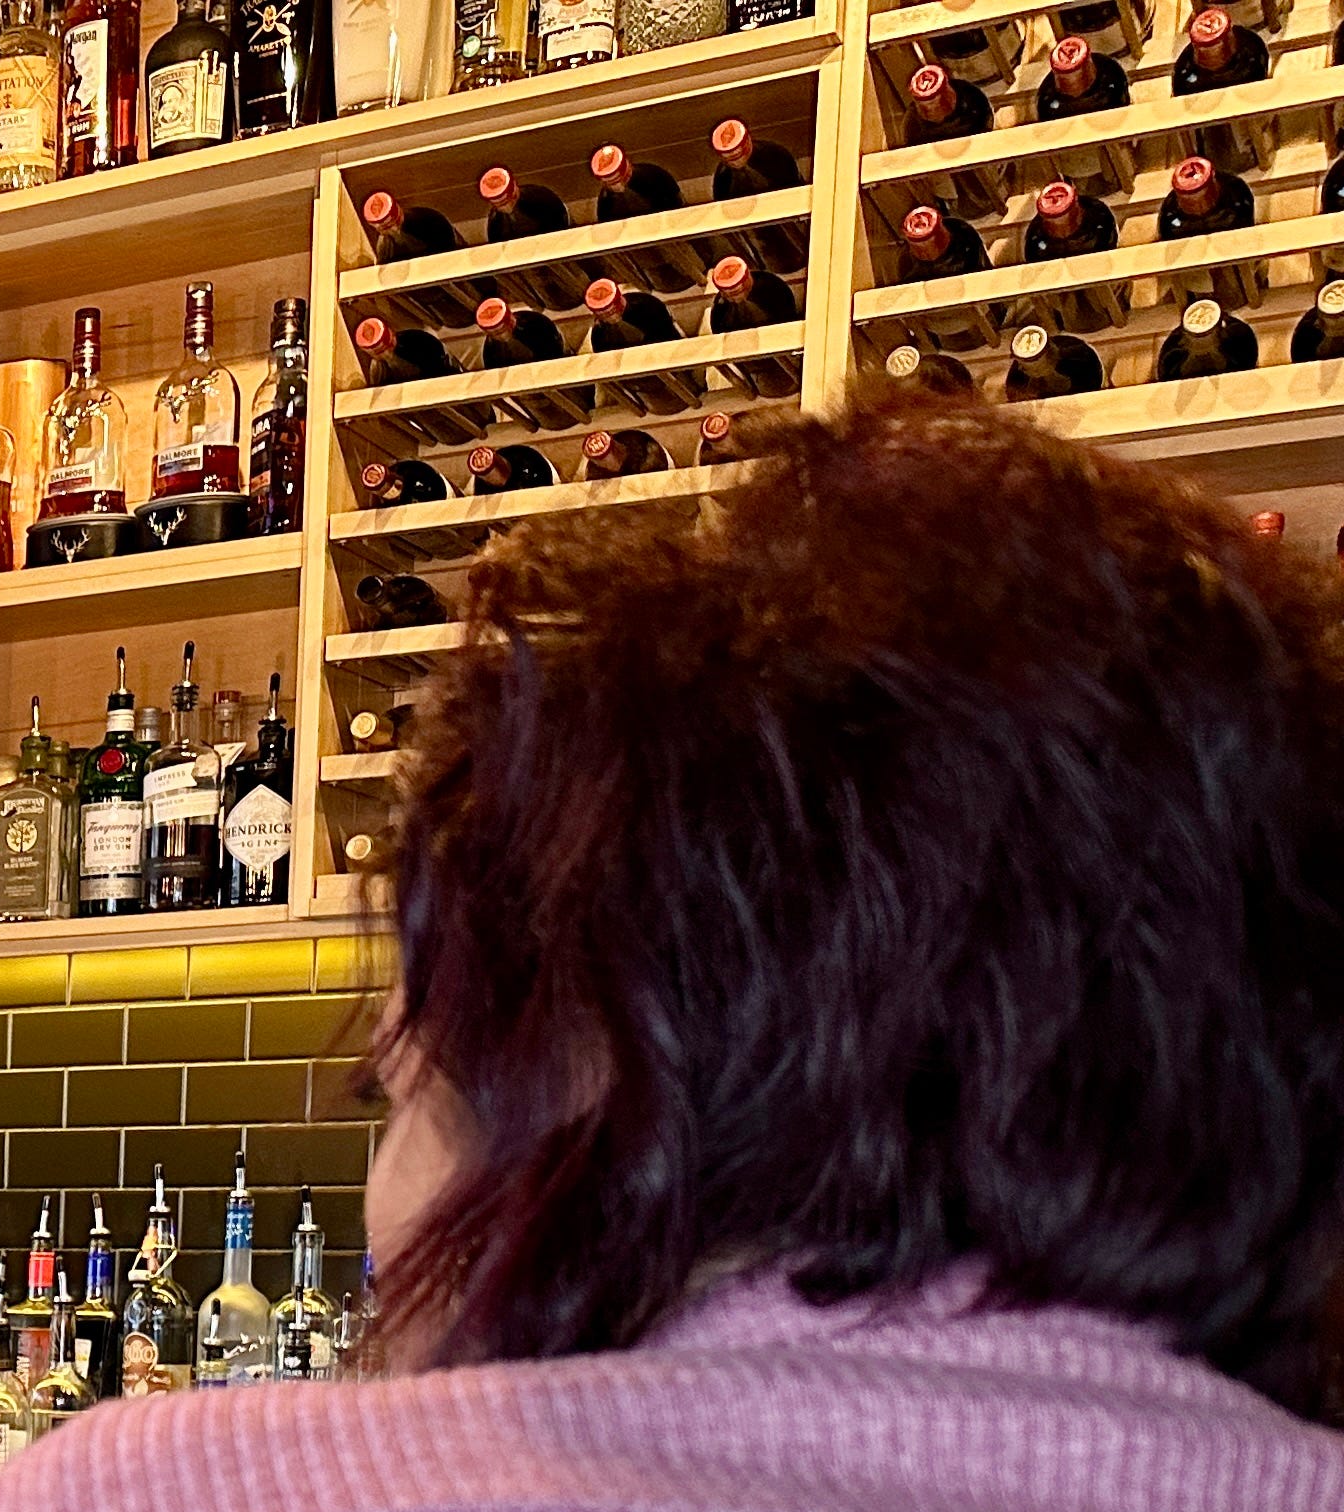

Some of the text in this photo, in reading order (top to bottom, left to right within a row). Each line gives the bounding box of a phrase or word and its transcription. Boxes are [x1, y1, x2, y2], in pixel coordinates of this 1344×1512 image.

[160, 447, 199, 463] DALMORE
[50, 467, 91, 483] DALMORE
[87, 821, 139, 835] Tanqueray
[226, 822, 292, 839] HENDRICK
[93, 836, 132, 845] LONDON
[93, 843, 132, 852] DRY GIN
